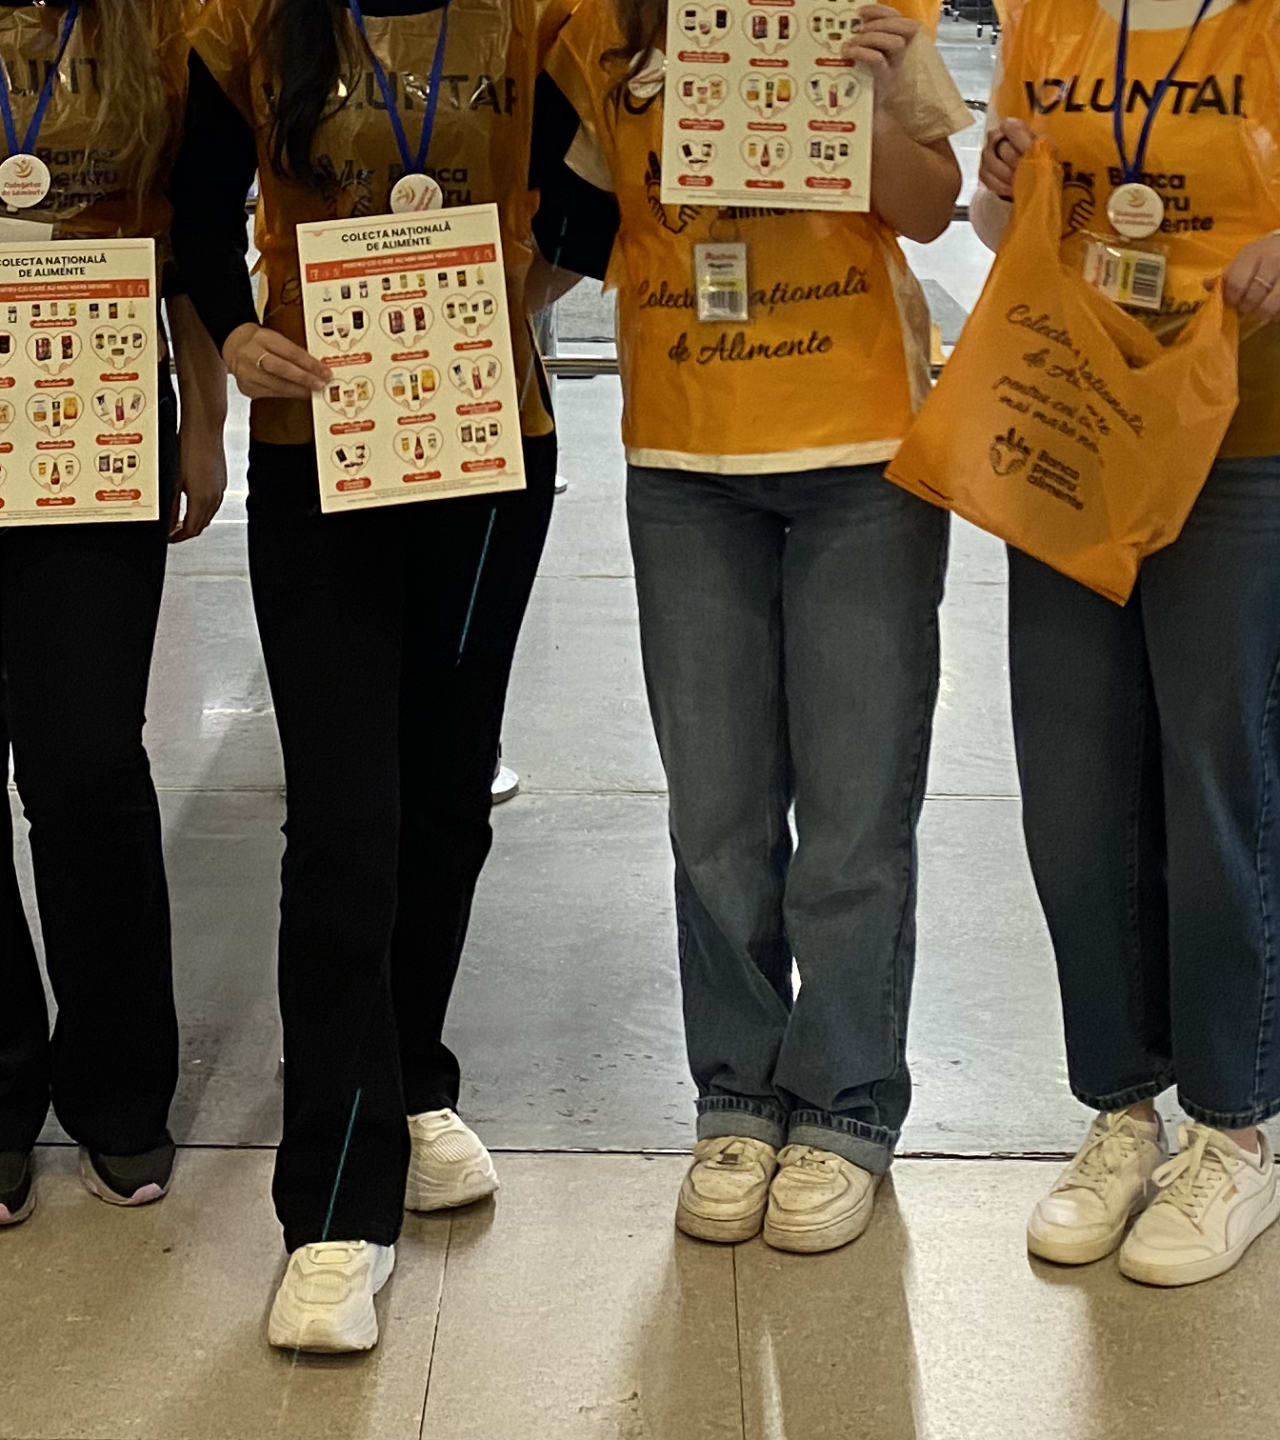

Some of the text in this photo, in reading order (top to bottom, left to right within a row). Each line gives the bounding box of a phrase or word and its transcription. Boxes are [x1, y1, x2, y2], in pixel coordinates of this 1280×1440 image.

[341, 220, 452, 243] COLECTA NAȚIONALĂ
[366, 236, 432, 252] DE ALIMENTE
[45, 253, 107, 269] NAȚIONALĂ
[18, 266, 86, 279] DE ALIMENTE
[748, 265, 870, 313] ațională
[668, 330, 834, 365] de Alimente
